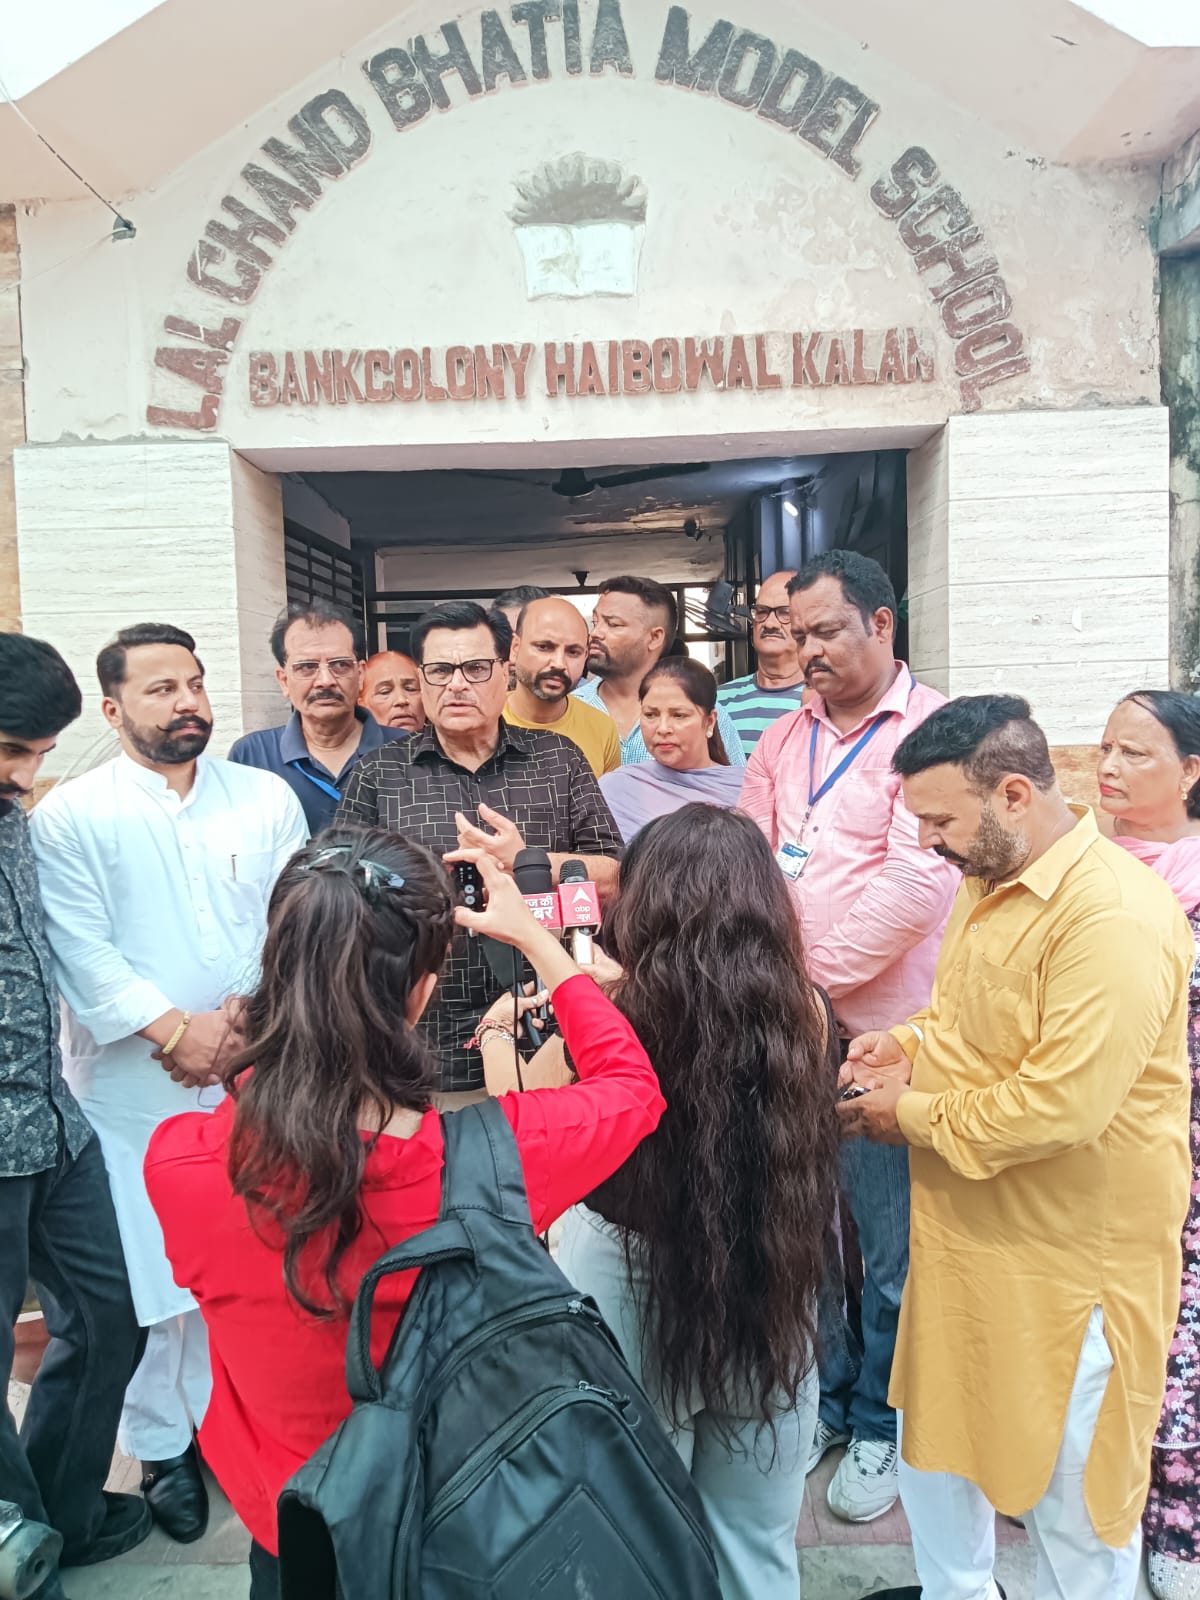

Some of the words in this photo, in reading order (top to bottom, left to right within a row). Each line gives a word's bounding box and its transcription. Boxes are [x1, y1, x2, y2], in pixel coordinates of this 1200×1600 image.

[363, 0, 634, 130] BHATIA
[655, 5, 878, 180] MODEL
[187, 88, 372, 303] CHAND
[870, 145, 1031, 413] SCHOOL
[146, 314, 241, 430] LAL
[544, 333, 780, 397] HAIBOWAL
